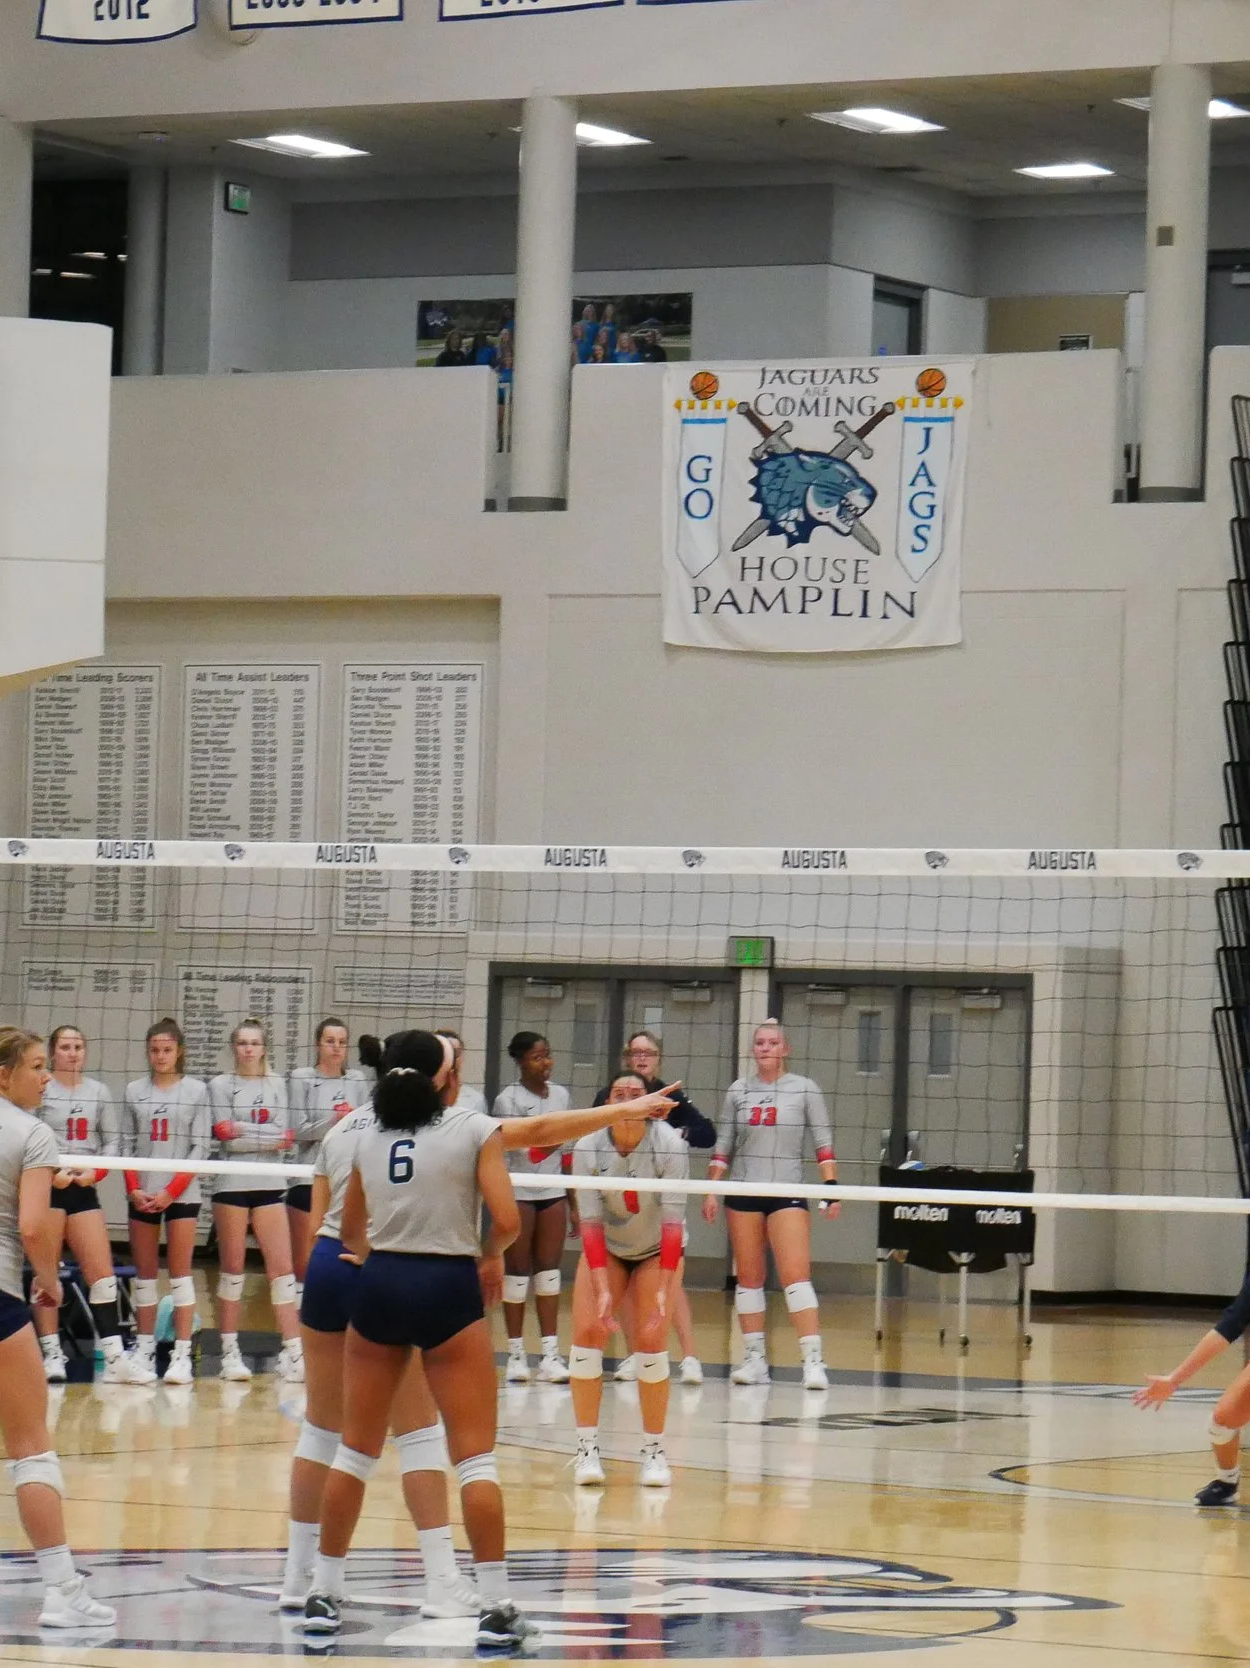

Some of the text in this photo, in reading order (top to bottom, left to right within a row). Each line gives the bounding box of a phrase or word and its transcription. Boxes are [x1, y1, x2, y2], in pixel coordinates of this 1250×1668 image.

[757, 367, 881, 390] JAGUARS
[804, 386, 829, 396] ARE
[754, 392, 878, 418] COMING
[683, 455, 715, 520] GO
[907, 426, 937, 554] JAGS
[739, 556, 870, 585] HOUSE
[691, 586, 918, 620] PAMPLIN
[271, 672, 309, 682] Leaders
[350, 671, 477, 682] Three Point Shot Leaders
[96, 841, 155, 859] AUGUSTA
[316, 845, 377, 863] AUGUSTA
[544, 848, 607, 867] AUGUSTA
[781, 850, 848, 869] AUGUSTA
[1027, 851, 1097, 870] AUGUSTA
[748, 1106, 778, 1126] 33
[150, 1118, 169, 1141] 11
[389, 1139, 415, 1184] 6
[893, 1205, 949, 1222] molten
[975, 1208, 1022, 1225] molten
